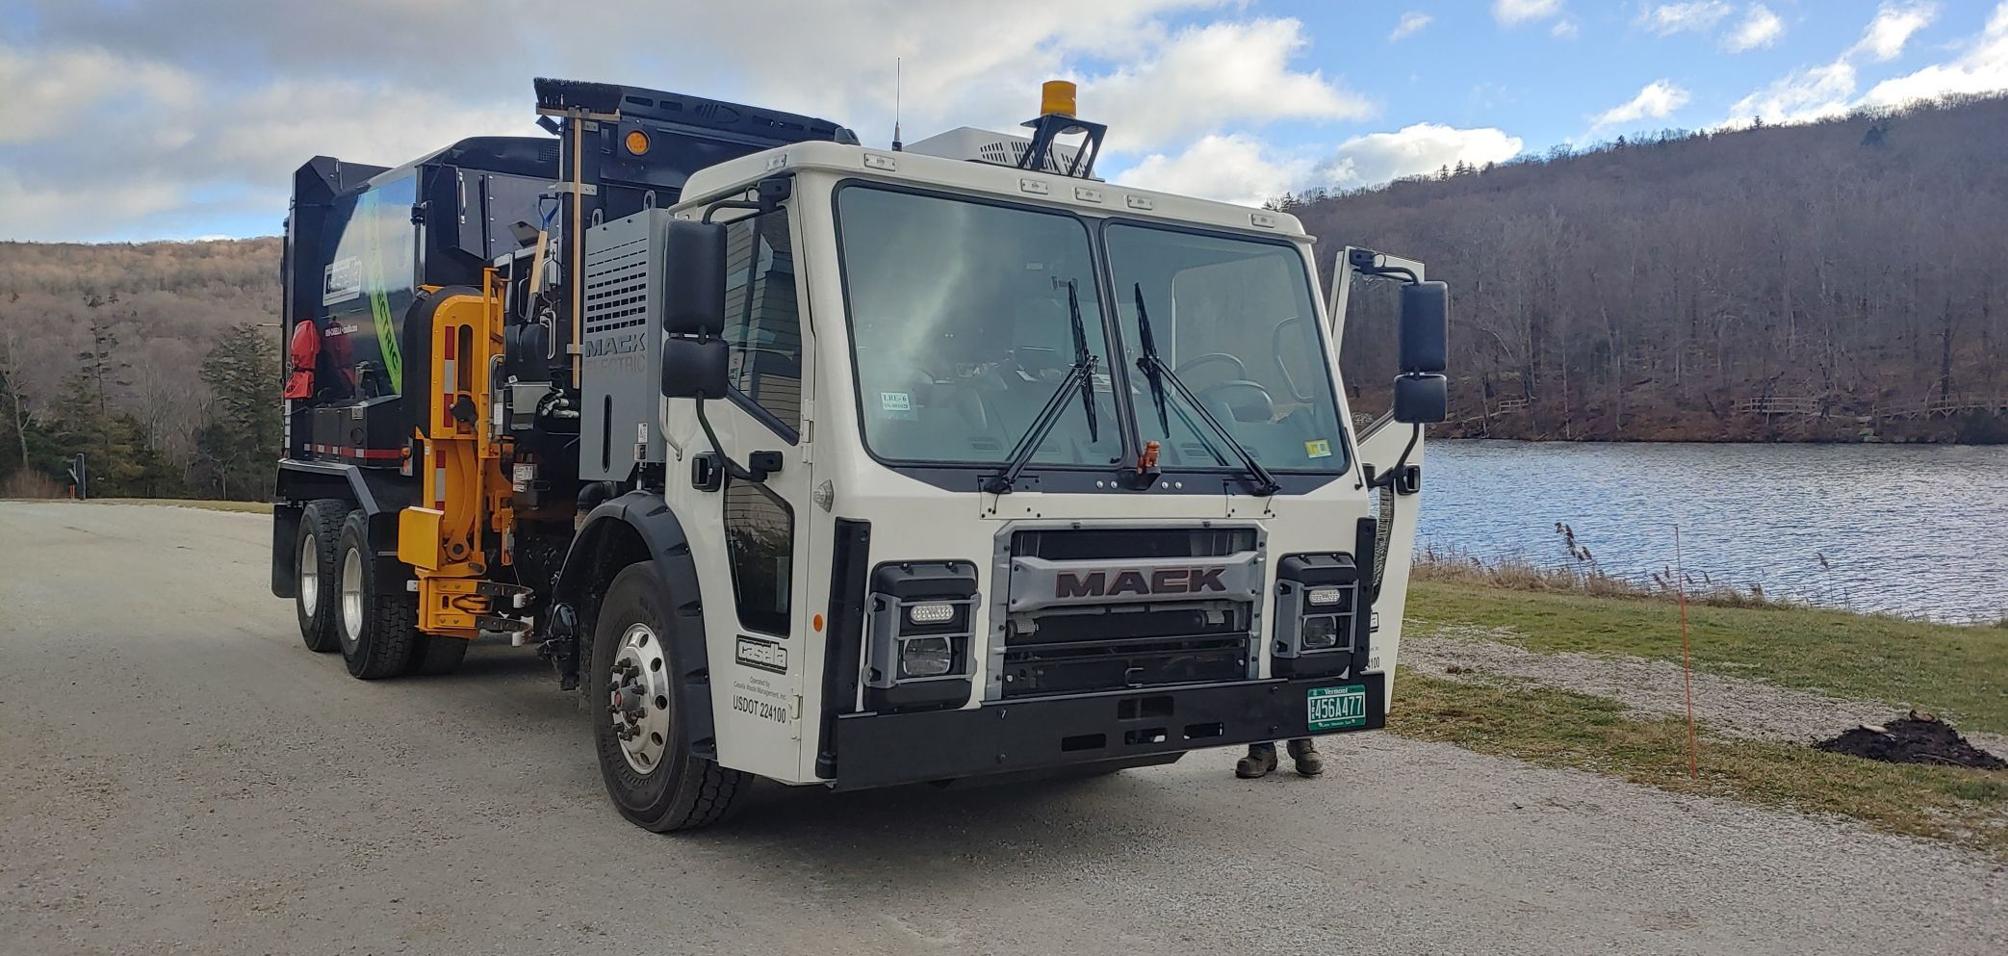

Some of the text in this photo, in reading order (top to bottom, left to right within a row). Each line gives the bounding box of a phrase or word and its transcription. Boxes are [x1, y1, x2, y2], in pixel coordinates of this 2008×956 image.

[584, 332, 646, 358] MACK
[1056, 565, 1226, 599] MACK
[1325, 687, 1348, 696] Vermont
[733, 695, 786, 724] USDOT 224100
[1315, 696, 1362, 719] 456A477
